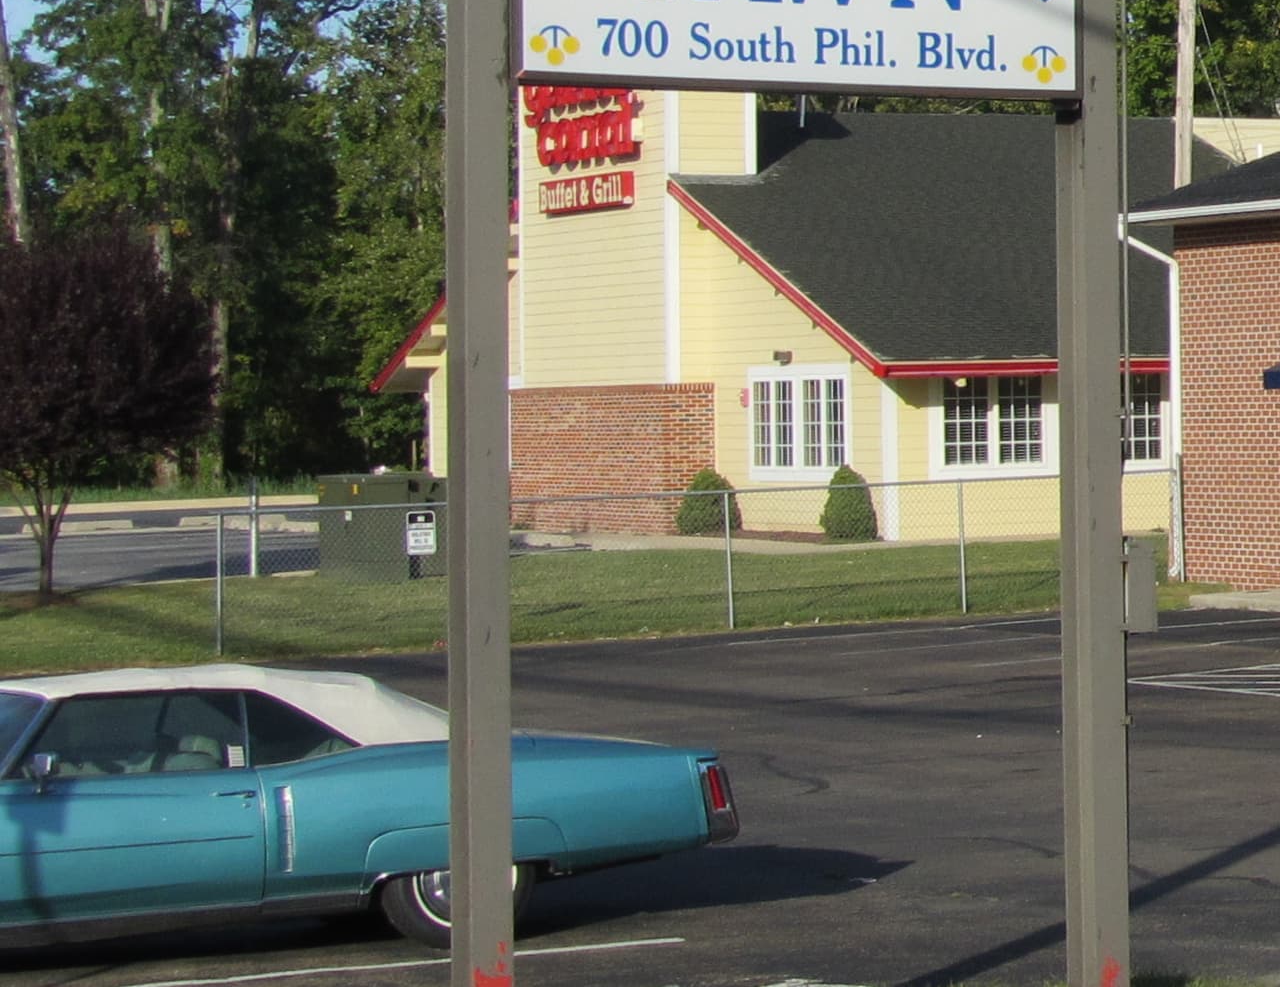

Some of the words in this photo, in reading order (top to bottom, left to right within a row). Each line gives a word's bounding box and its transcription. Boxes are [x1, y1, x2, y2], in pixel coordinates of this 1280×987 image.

[596, 17, 669, 59] 700
[688, 21, 796, 65] South
[814, 26, 897, 69] Phil.
[916, 30, 1008, 72] Blvd.
[540, 179, 576, 211] Buffet
[580, 179, 589, 206] &
[592, 173, 621, 204] Grill
